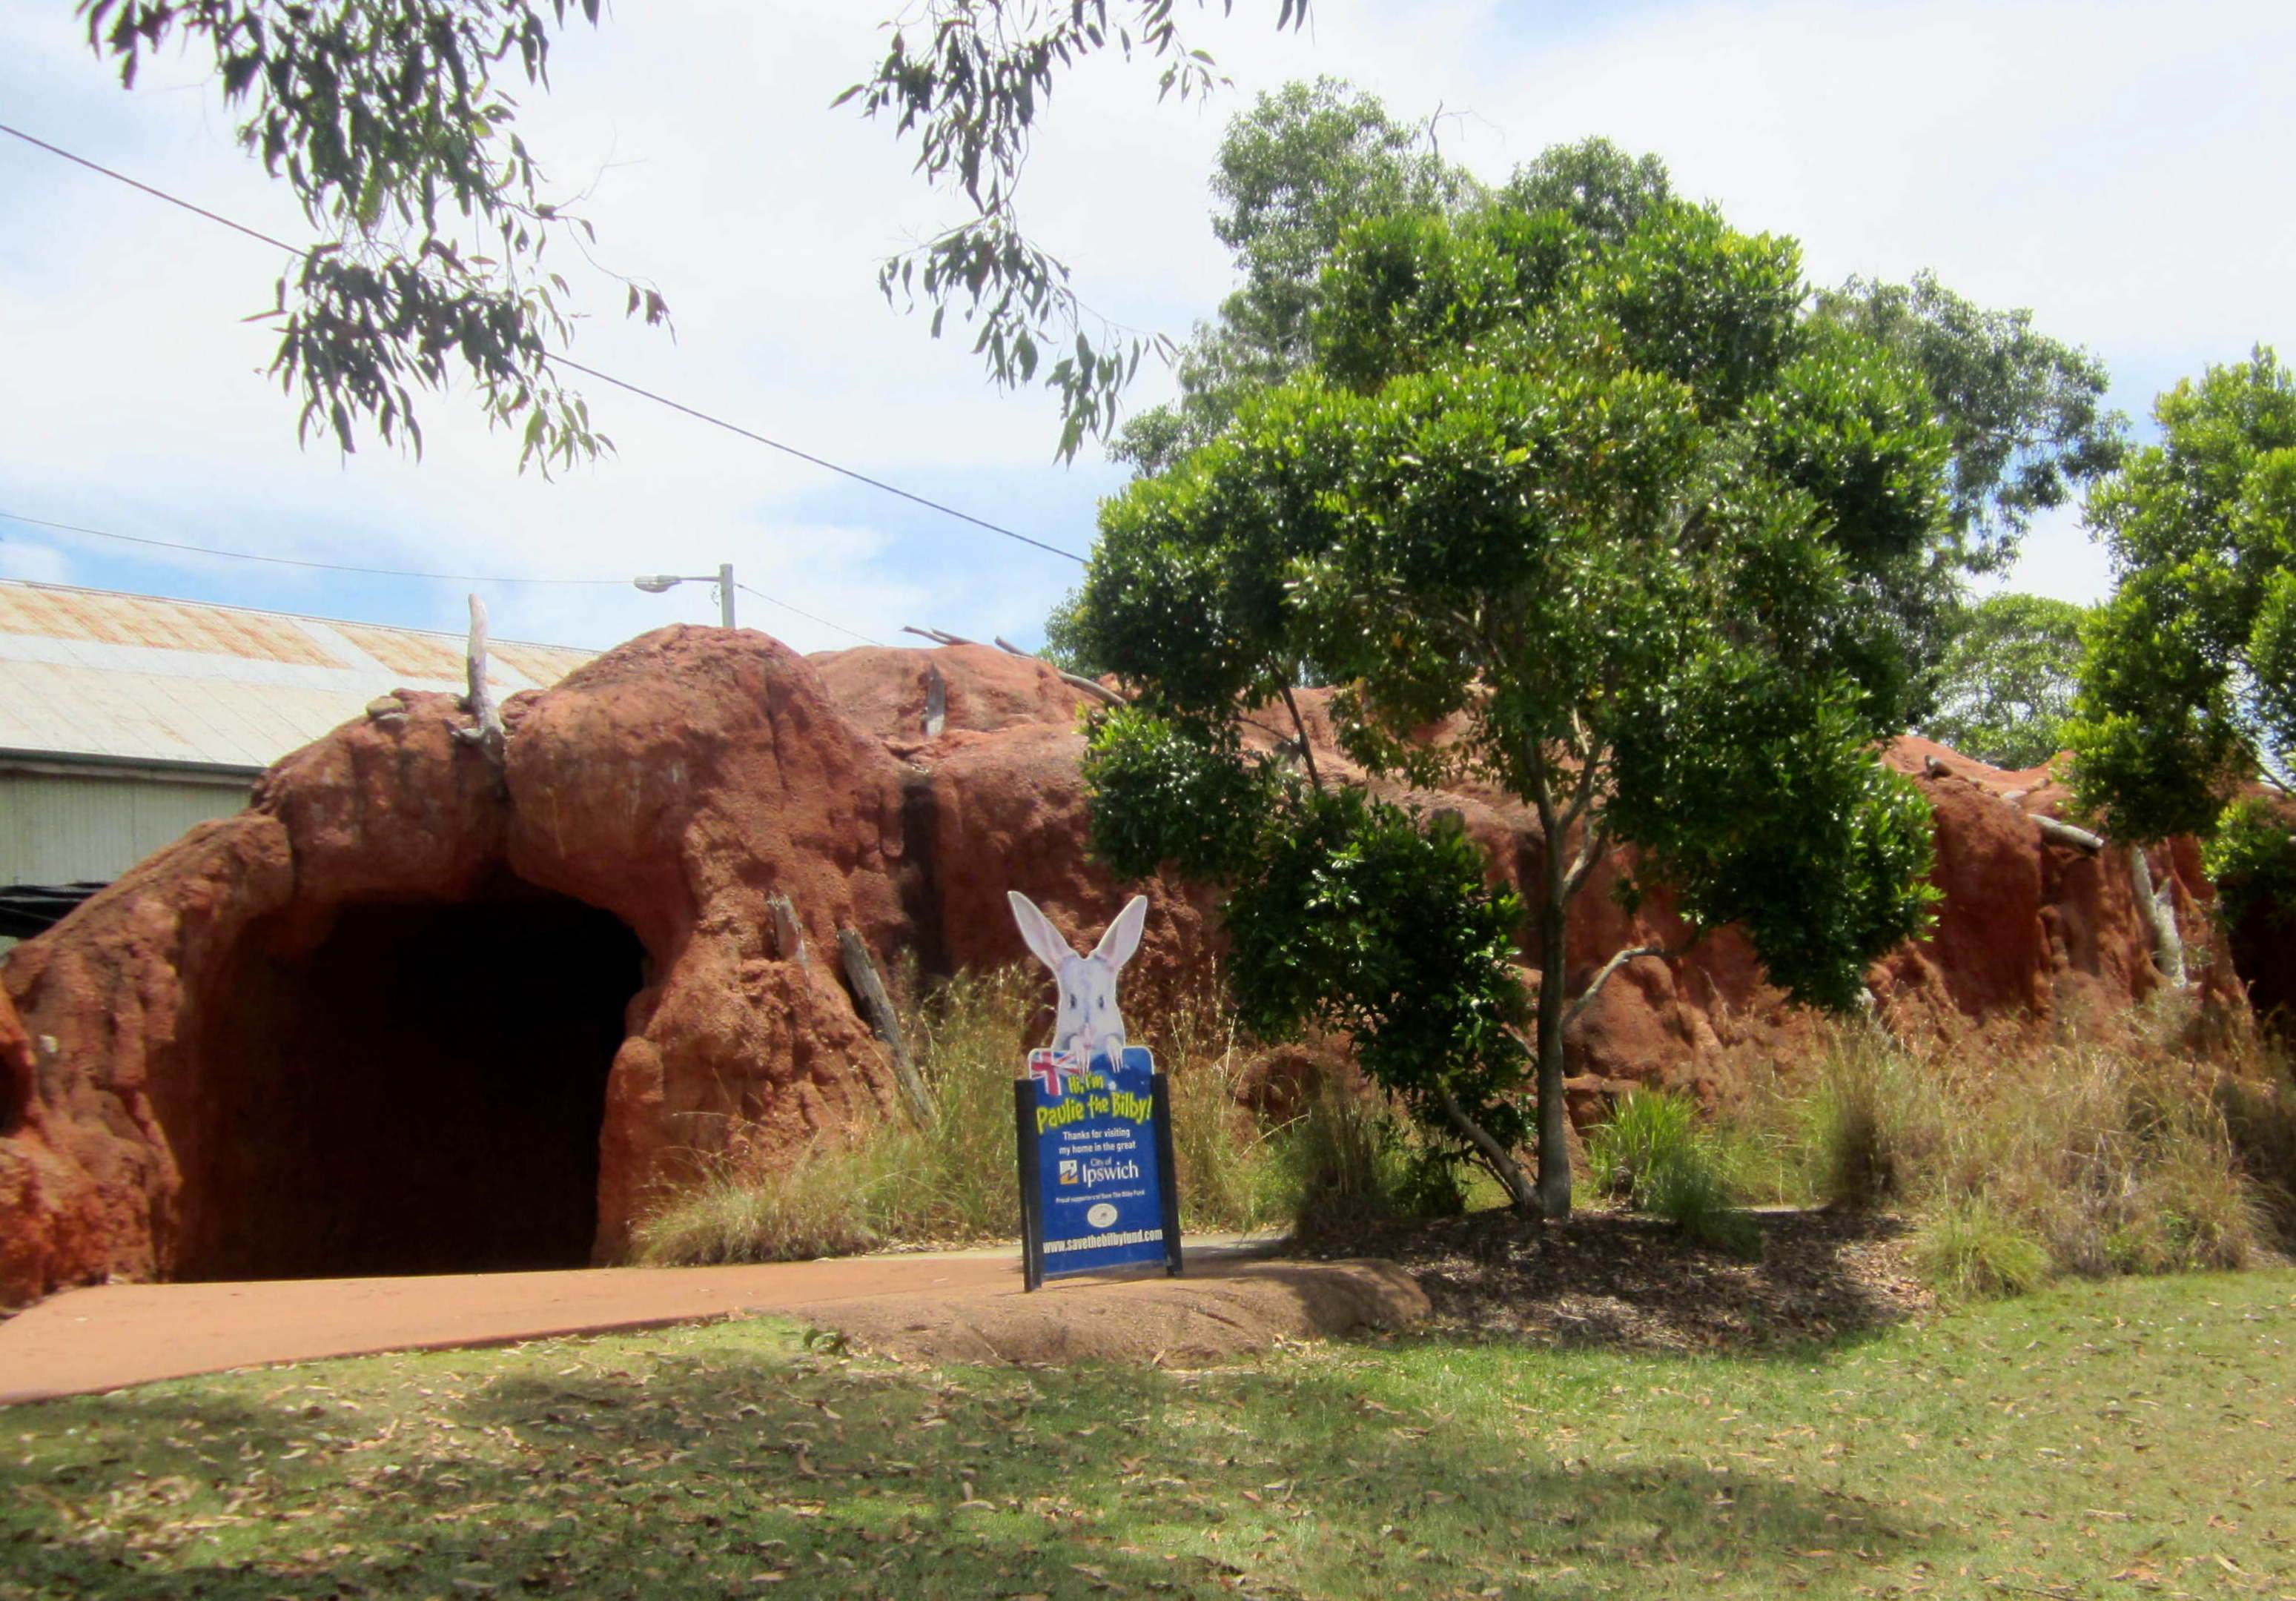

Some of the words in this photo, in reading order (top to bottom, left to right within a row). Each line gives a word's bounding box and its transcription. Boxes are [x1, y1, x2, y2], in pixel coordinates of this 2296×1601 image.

[1068, 1075, 1084, 1094] Hi,
[1036, 1098, 1085, 1135] Paulie
[1088, 1094, 1109, 1118] the
[1112, 1091, 1153, 1125] Bilby!
[1062, 1131, 1091, 1141] Thanks
[1091, 1130, 1102, 1138] for
[1104, 1127, 1131, 1138] visiting
[1059, 1147, 1071, 1156] my
[1072, 1144, 1093, 1154] home
[1094, 1142, 1102, 1152] in
[1103, 1141, 1115, 1151] the
[1116, 1141, 1136, 1152] great
[1091, 1158, 1104, 1167] City
[1105, 1157, 1112, 1165] of
[1082, 1159, 1139, 1187] Ipswich
[1042, 1229, 1163, 1253] www.savethebilbyfund.com
